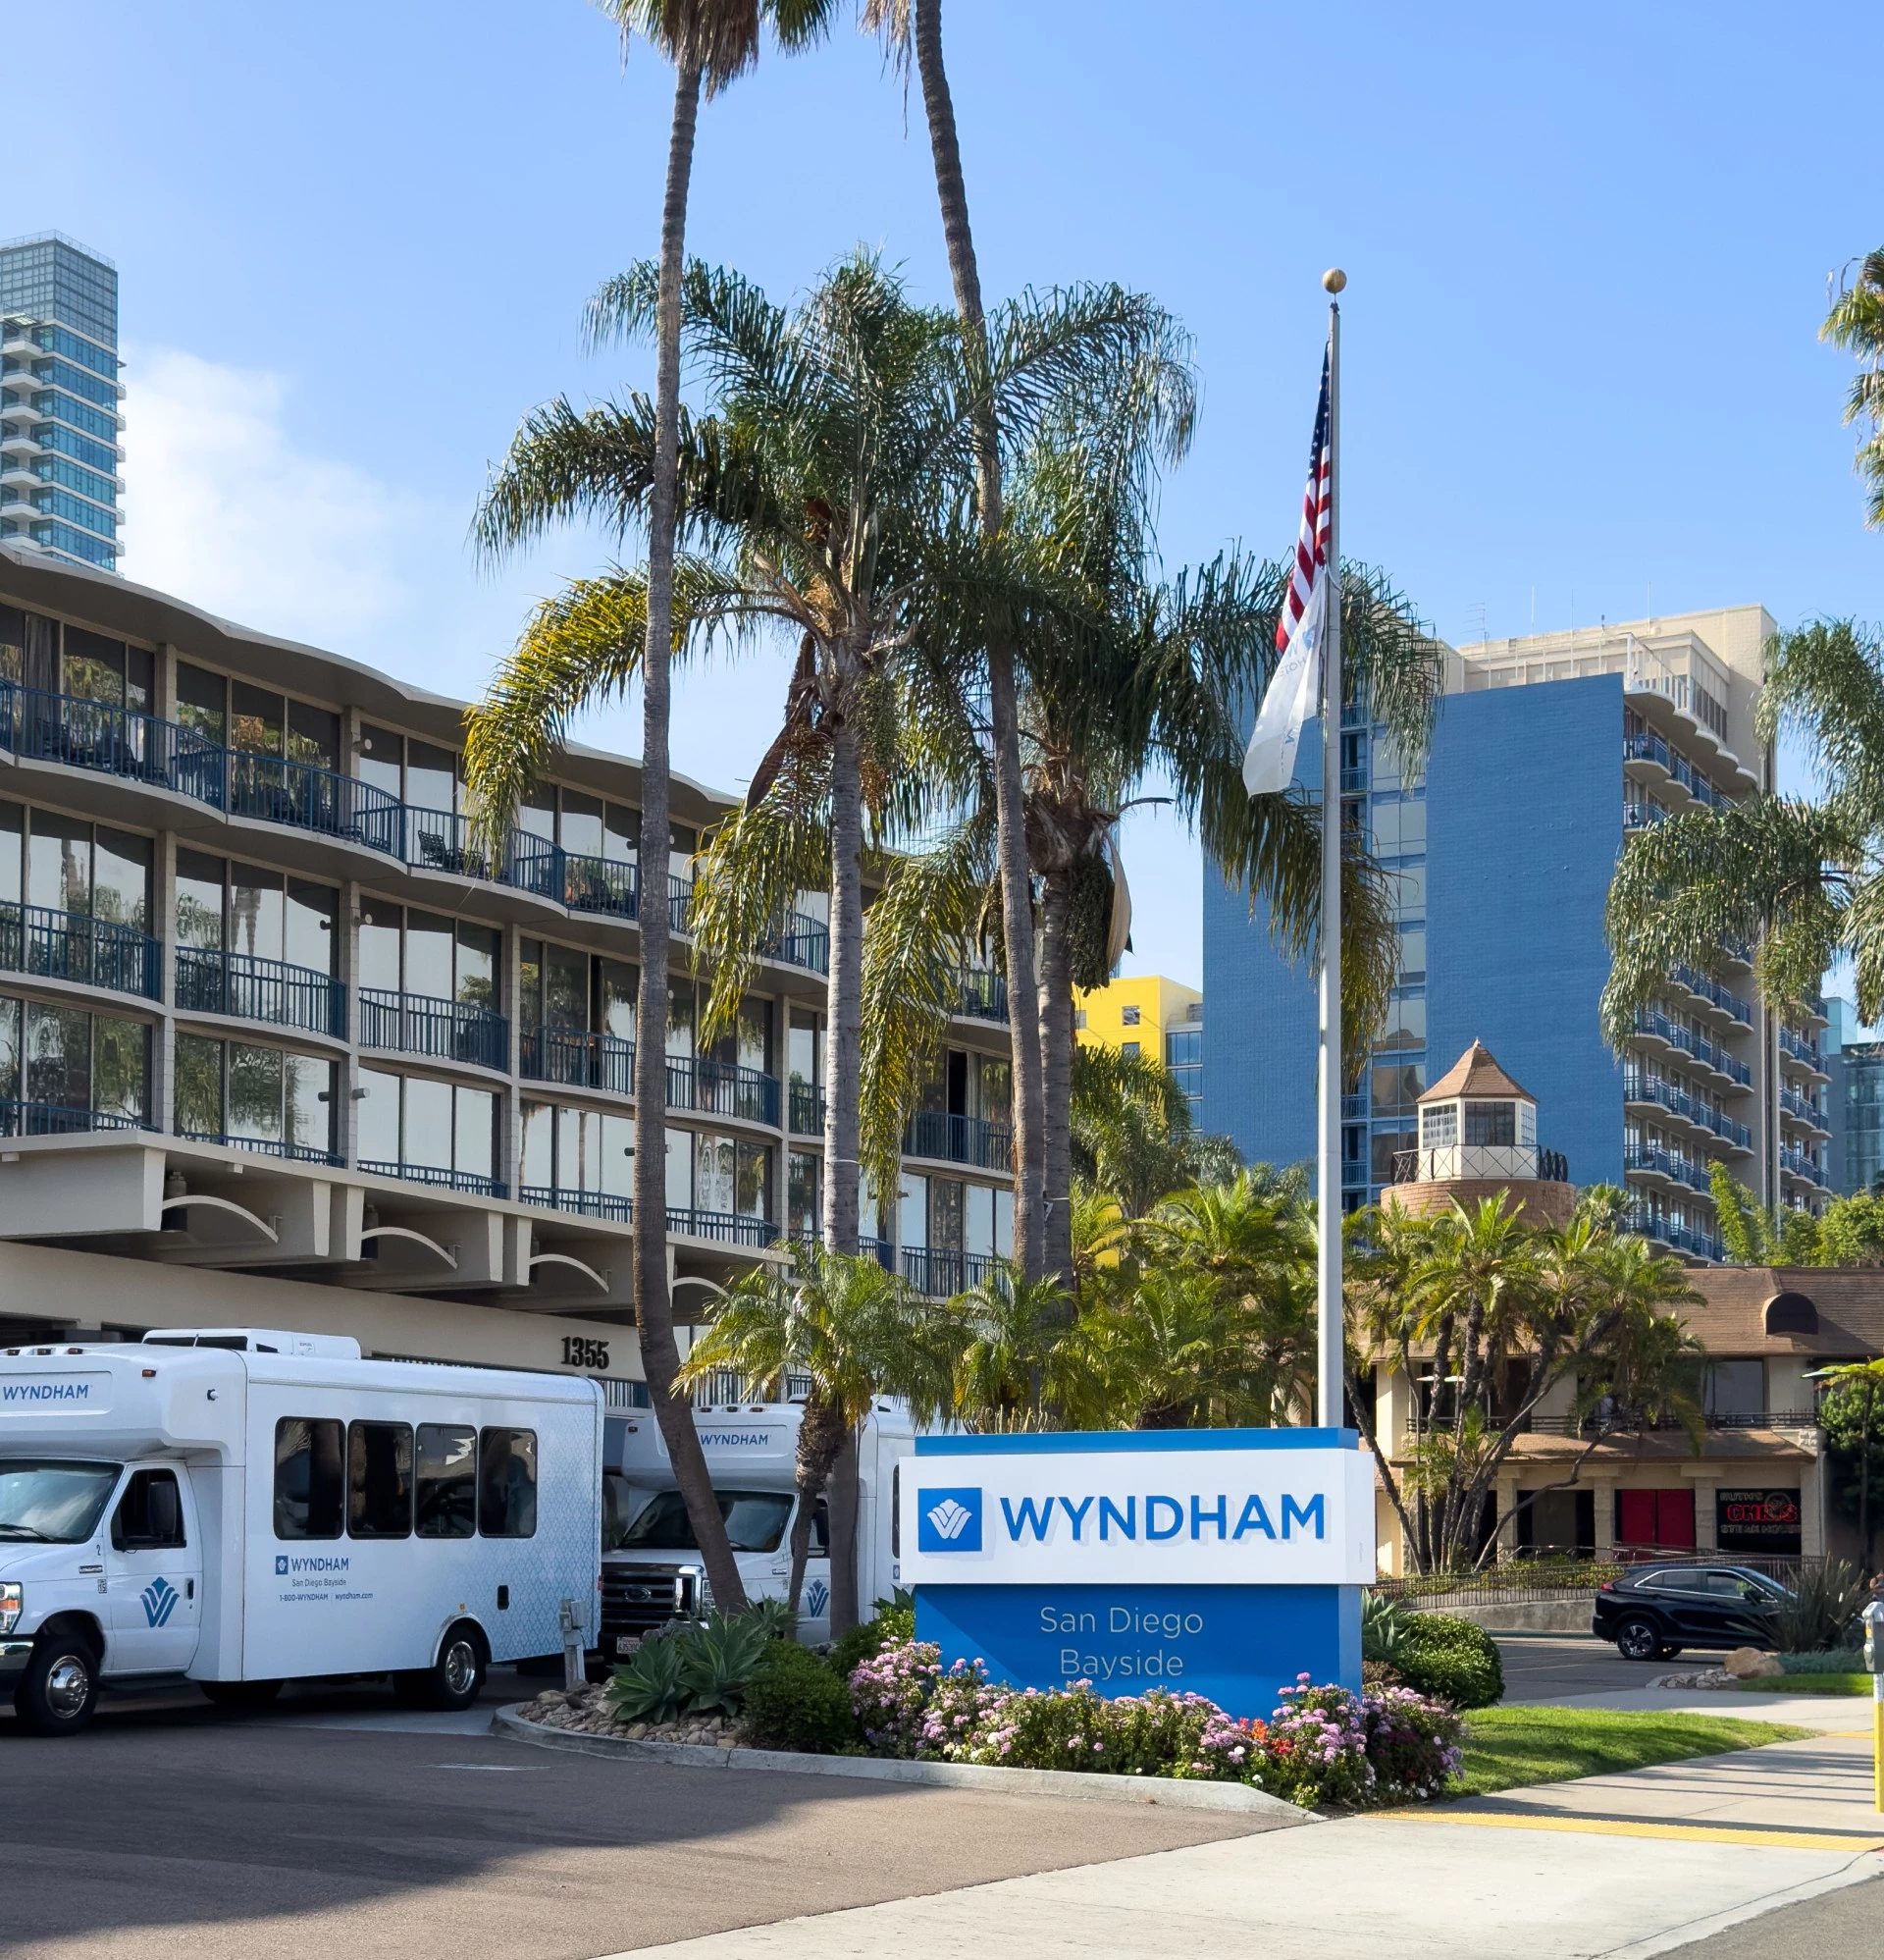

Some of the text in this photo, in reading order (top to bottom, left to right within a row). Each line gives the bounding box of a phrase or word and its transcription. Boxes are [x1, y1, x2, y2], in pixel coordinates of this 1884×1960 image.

[560, 1336, 609, 1370] 1355
[3, 1384, 89, 1401] WYNDHAM
[700, 1434, 769, 1446] WYNDHAM
[999, 1493, 1325, 1542] WYNDHAM
[290, 1557, 349, 1572] WYNDHAM
[291, 1577, 347, 1588] San Diego Bayside
[279, 1592, 374, 1602] 1-800-WYNDHAM wyndham.com
[1040, 1606, 1204, 1639] San Diego
[1060, 1648, 1183, 1681] Bayside
